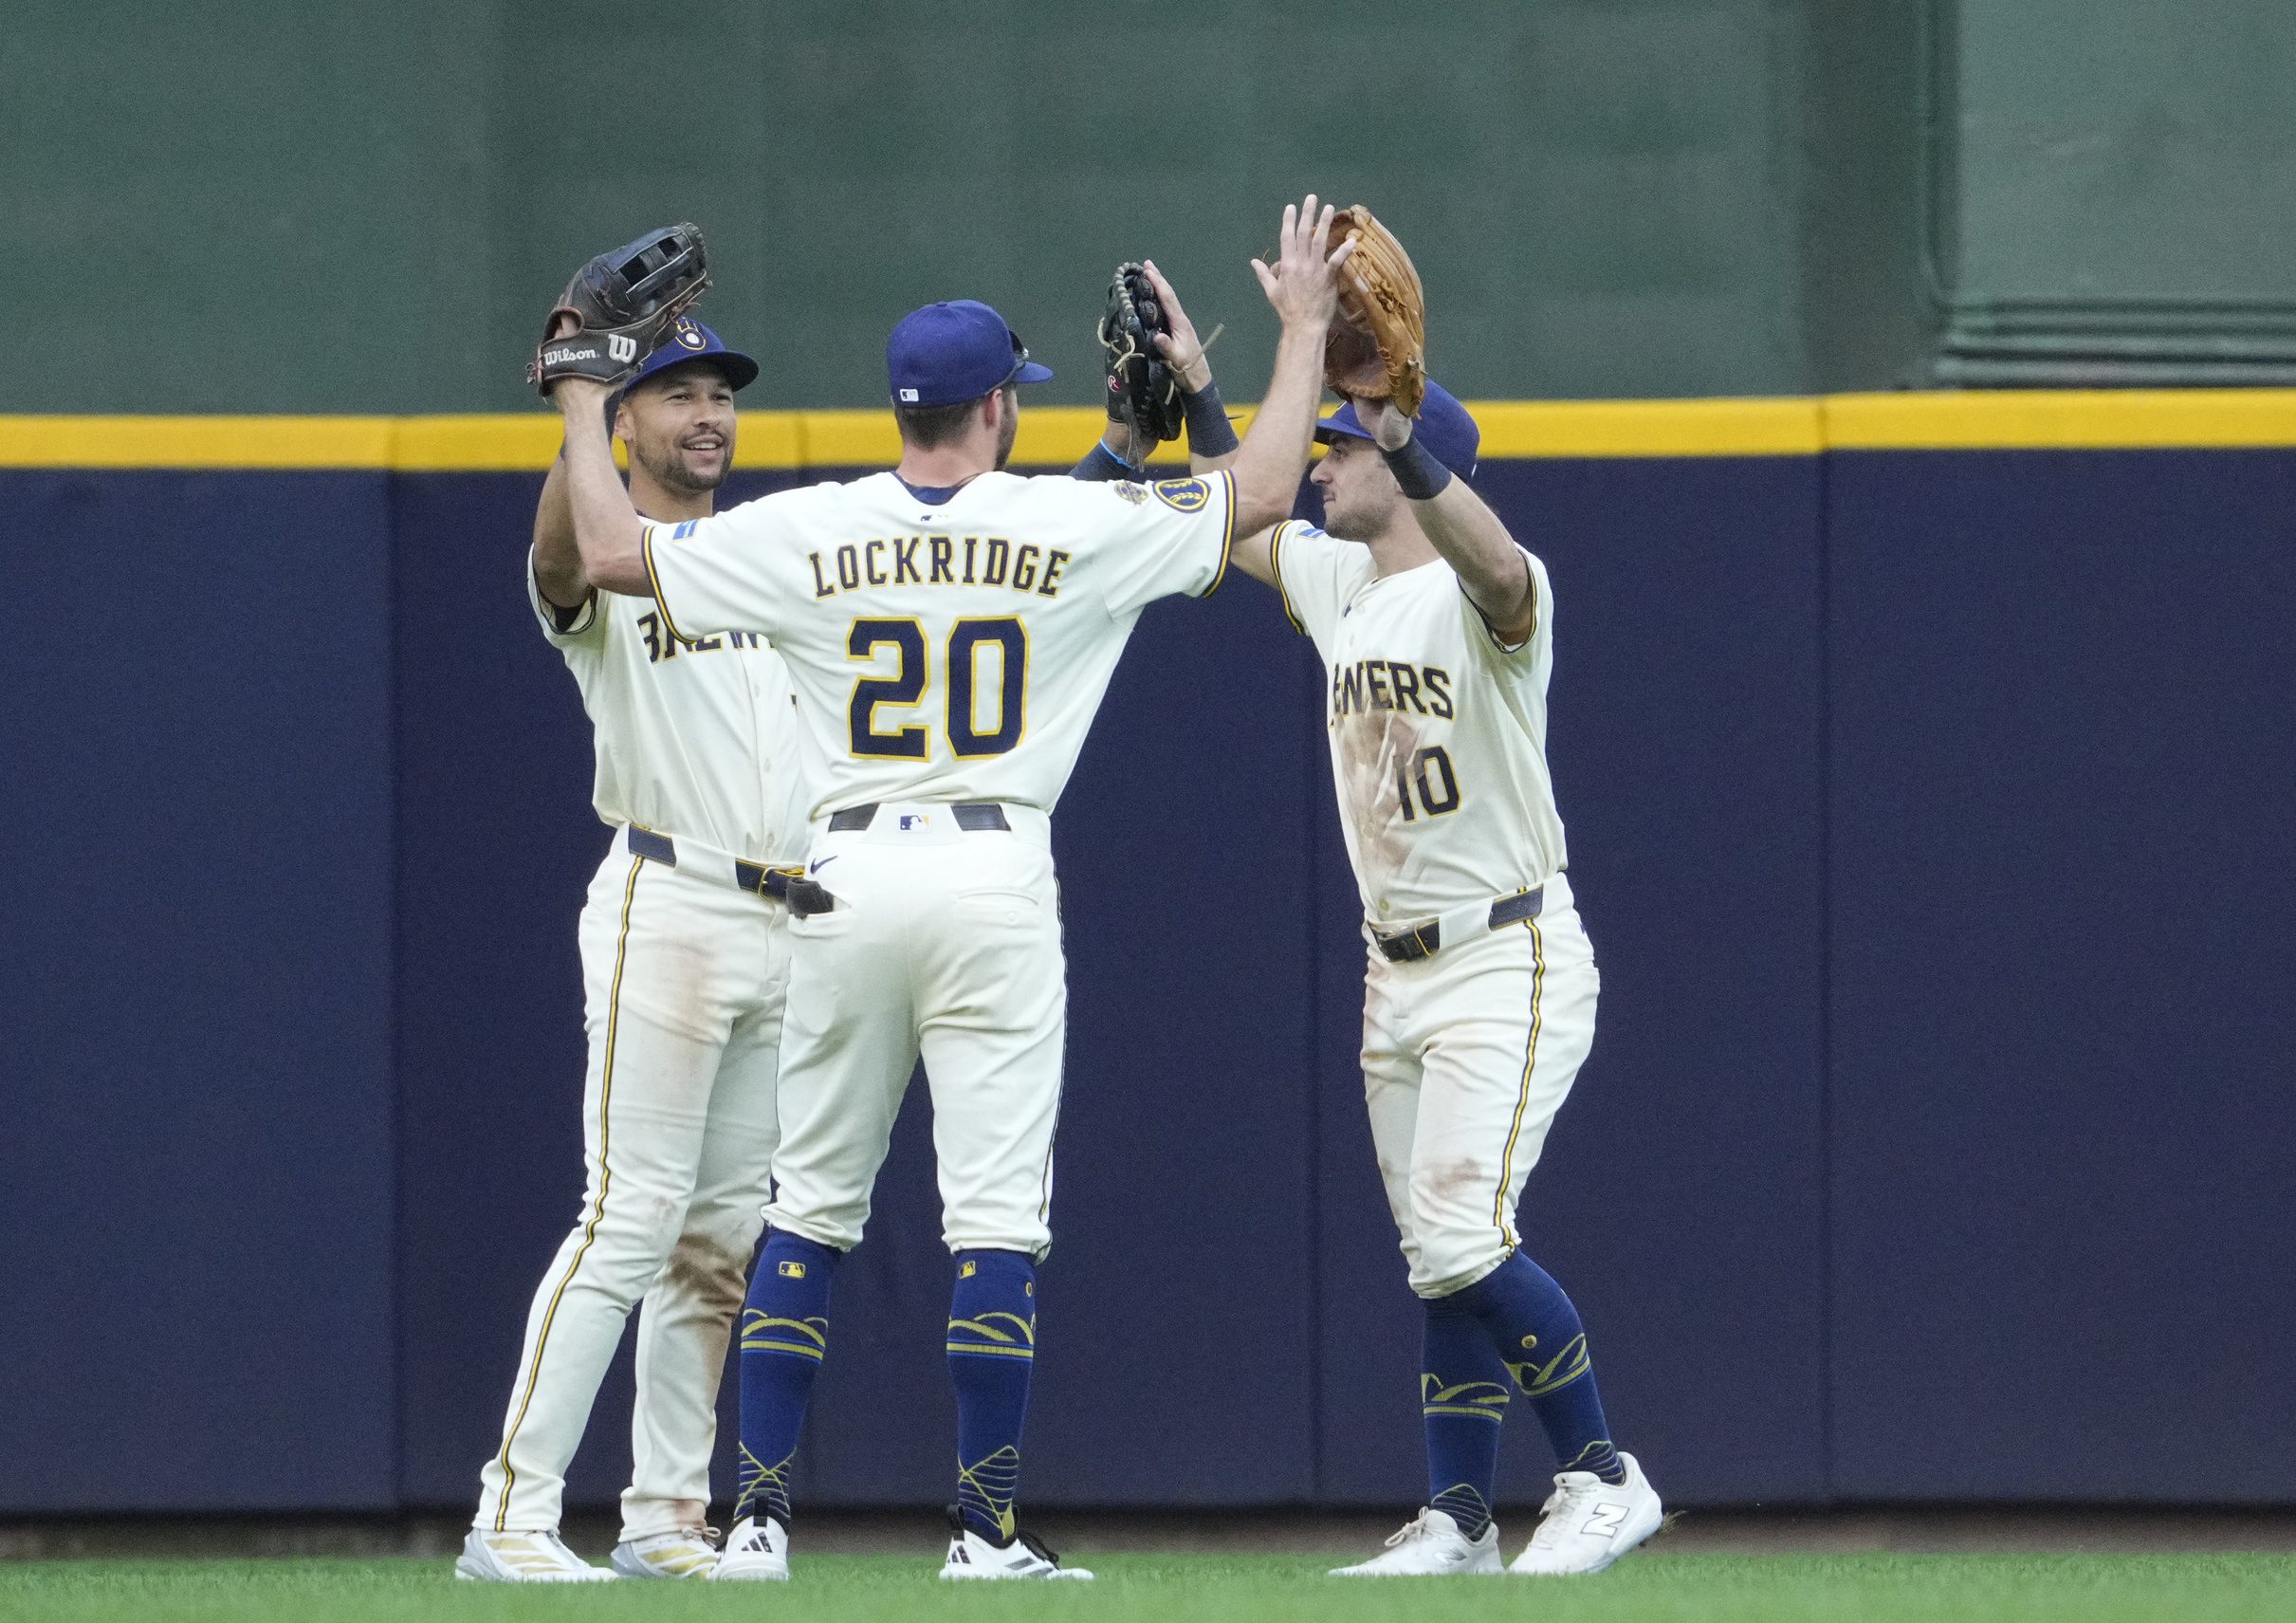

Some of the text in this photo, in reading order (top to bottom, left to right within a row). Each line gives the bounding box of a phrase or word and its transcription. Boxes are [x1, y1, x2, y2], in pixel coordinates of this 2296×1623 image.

[543, 348, 597, 366] Wilson
[809, 536, 1073, 599] LOCKRIDGE
[846, 615, 1031, 763] 20
[1391, 744, 1461, 825] 10
